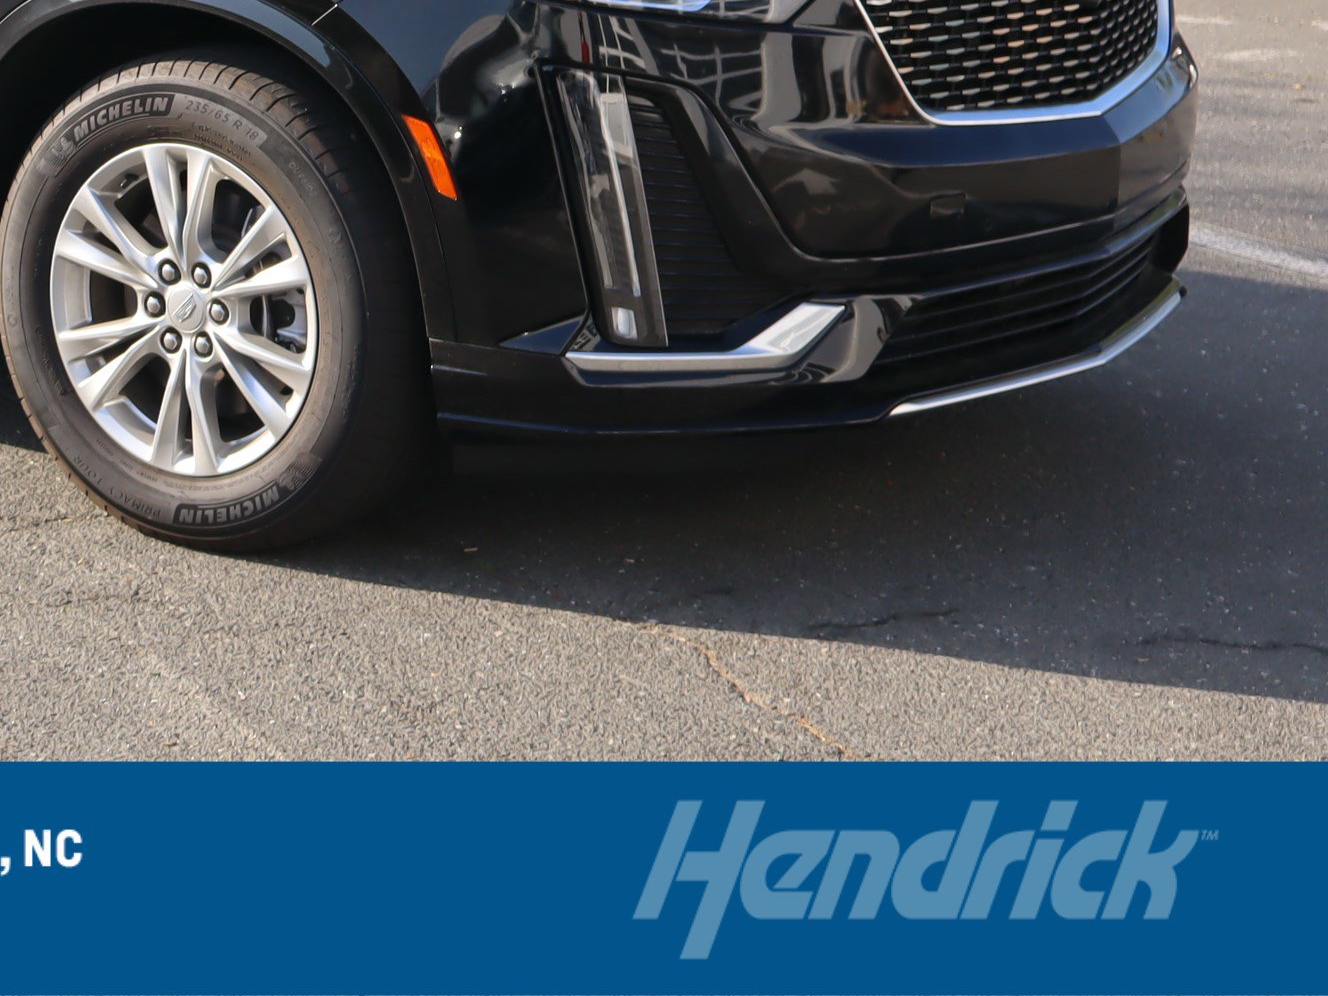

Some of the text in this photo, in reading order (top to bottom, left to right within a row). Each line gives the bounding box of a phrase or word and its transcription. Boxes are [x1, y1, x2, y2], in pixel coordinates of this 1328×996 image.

[73, 96, 169, 142] MICHELIN
[185, 99, 232, 124] 235/65
[109, 485, 162, 519] PRIMACY
[178, 482, 281, 525] MICHELIN
